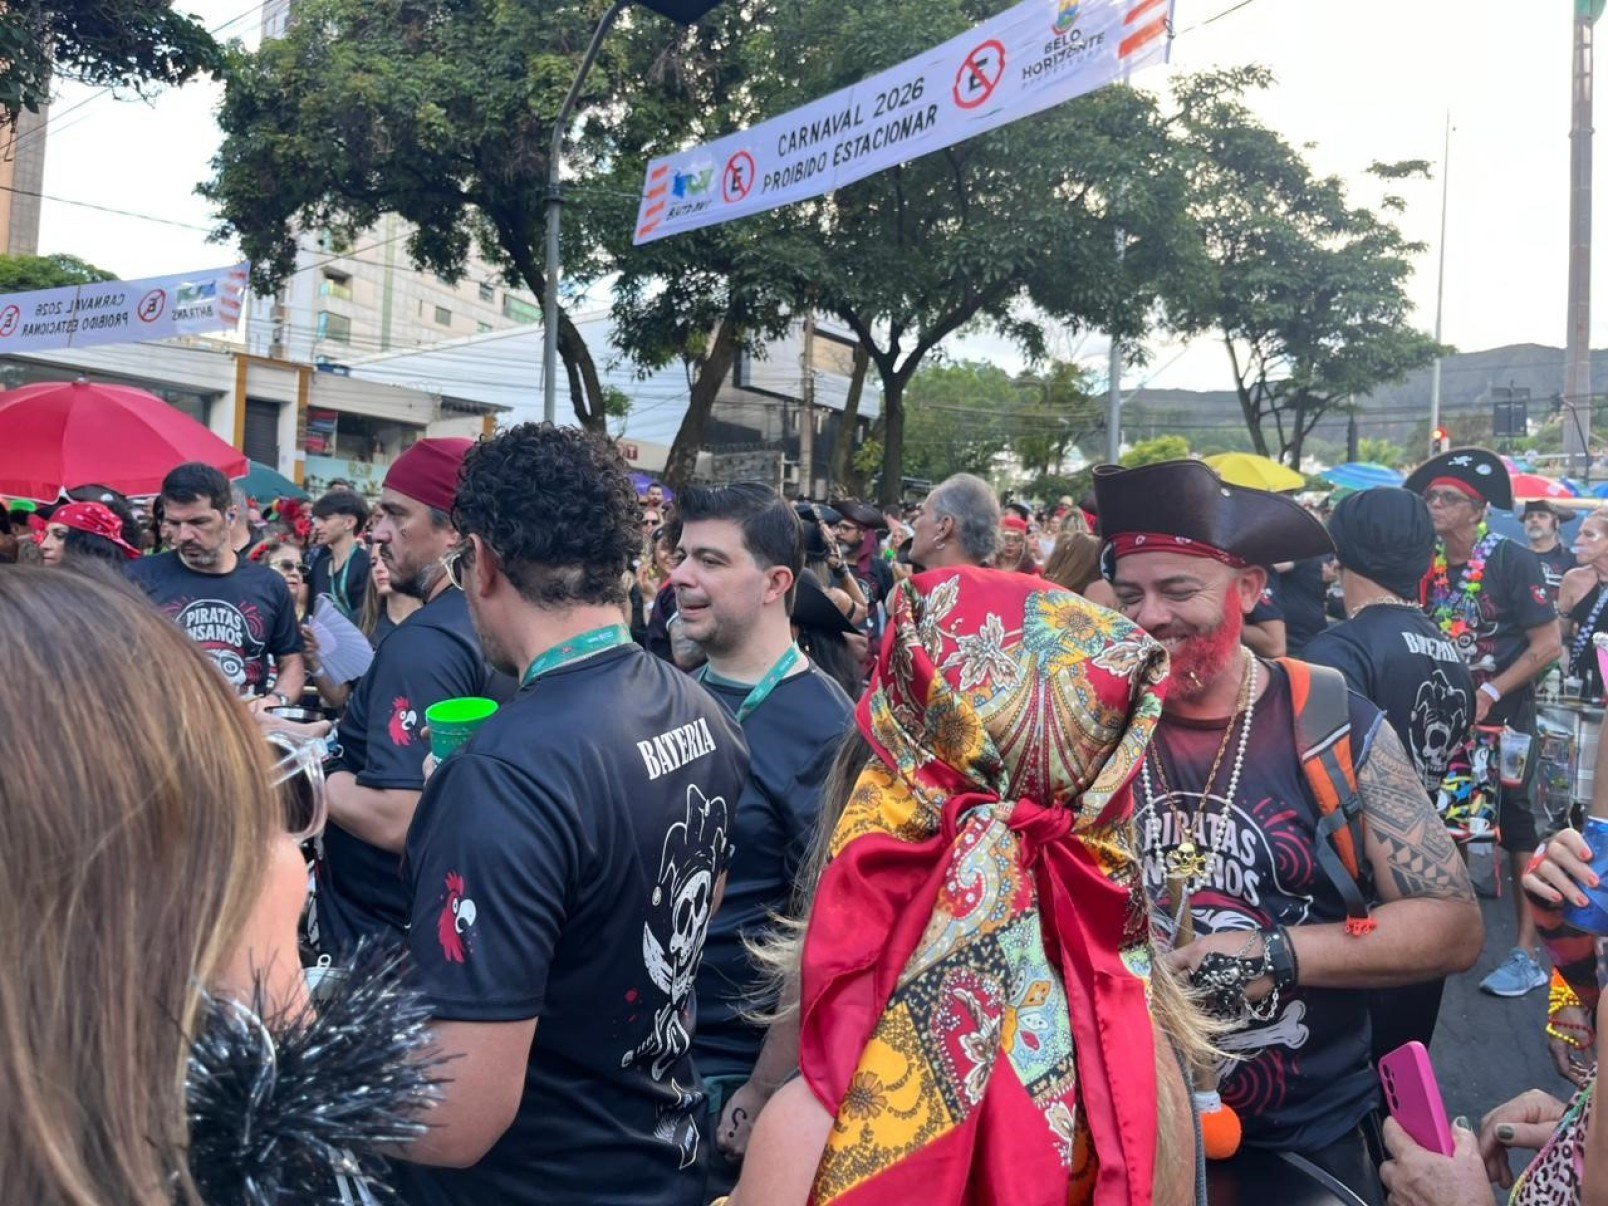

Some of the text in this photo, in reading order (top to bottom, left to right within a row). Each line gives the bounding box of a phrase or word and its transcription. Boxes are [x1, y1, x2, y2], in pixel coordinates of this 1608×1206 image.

[1045, 29, 1081, 54] BELO
[778, 77, 924, 157] CARNAVAL 2026
[762, 104, 938, 195] PROIBIDO ESTACIONAR
[186, 607, 241, 631] PIRATAS
[186, 624, 243, 648] NSANOS
[636, 717, 717, 780] BATERIA
[1143, 811, 1256, 867] PIRATAS
